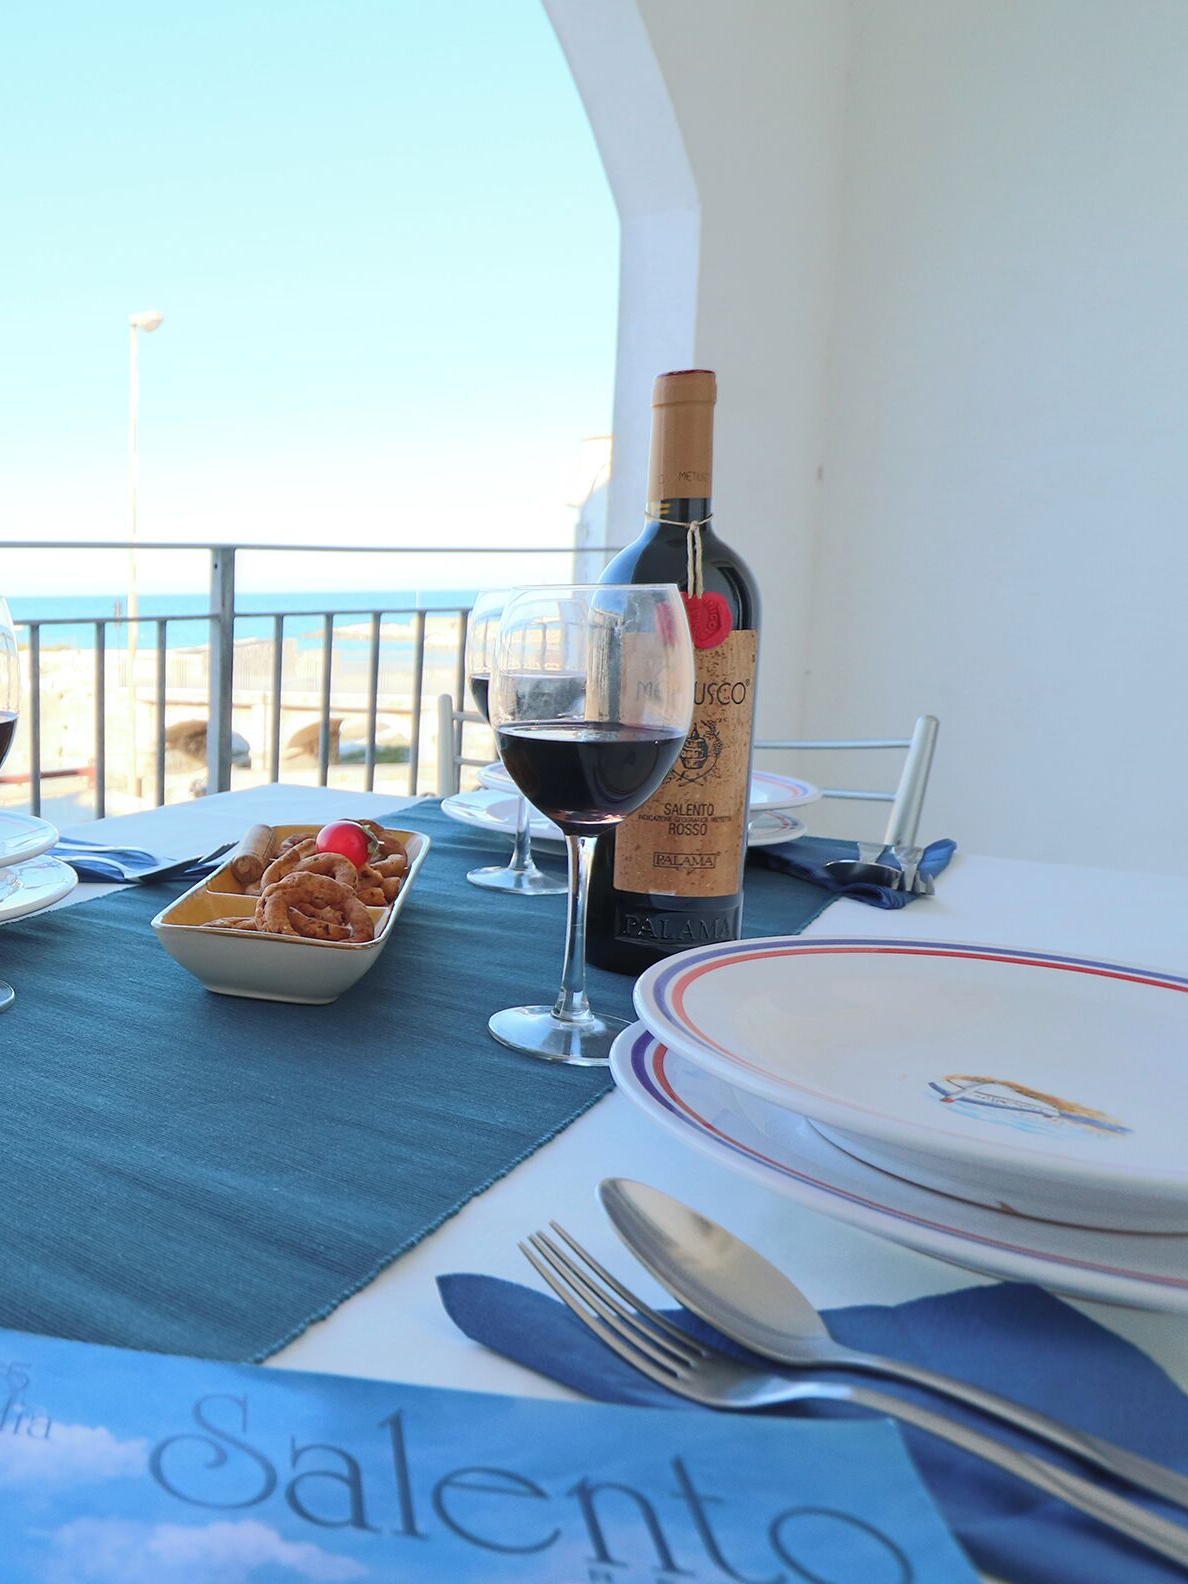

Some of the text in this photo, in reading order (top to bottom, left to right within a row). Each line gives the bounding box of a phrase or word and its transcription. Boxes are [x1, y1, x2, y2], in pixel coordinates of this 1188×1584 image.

[663, 802, 715, 817] SALENTO
[668, 823, 708, 836] ROSSO
[148, 1393, 915, 1584] Salento
